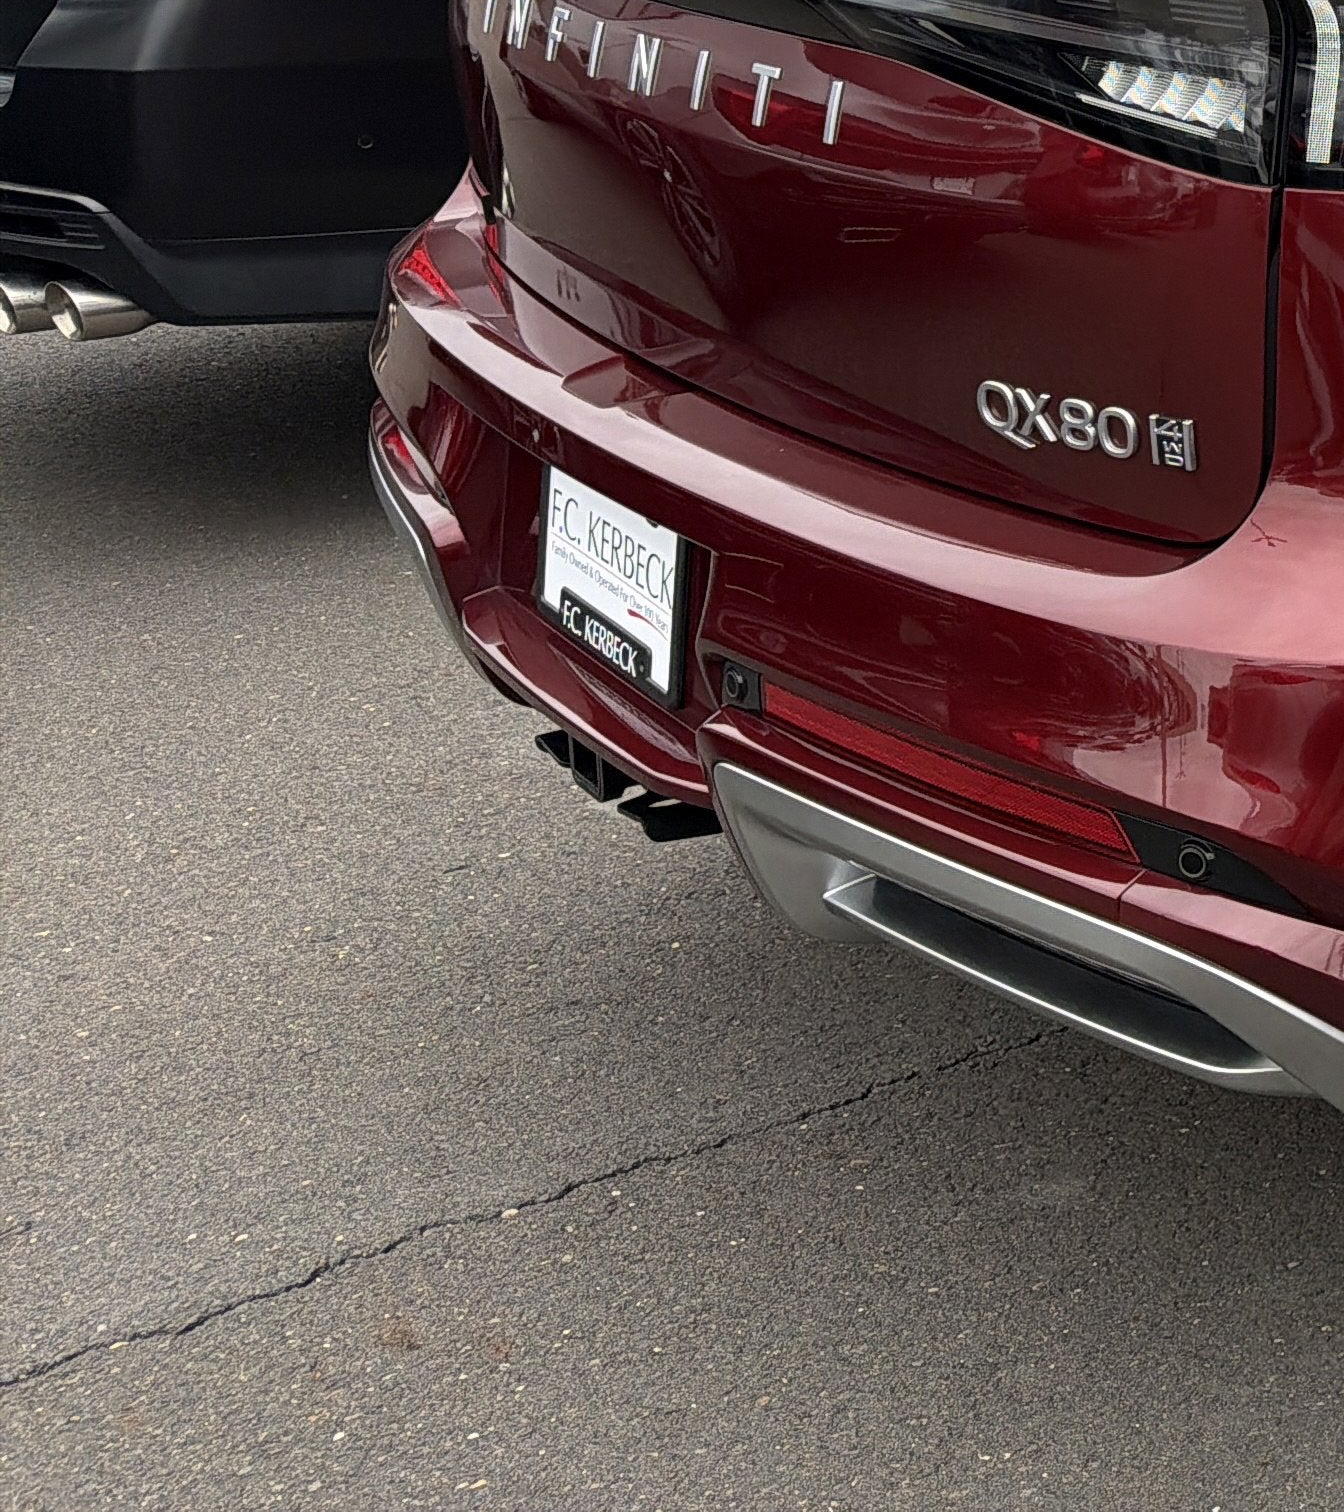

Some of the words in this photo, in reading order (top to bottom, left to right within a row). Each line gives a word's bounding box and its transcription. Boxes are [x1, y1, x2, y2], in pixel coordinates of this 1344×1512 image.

[976, 379, 1139, 460] QX80
[551, 487, 582, 546] F.C.
[587, 510, 675, 610] KERBECK
[562, 599, 583, 638] F.C.
[584, 616, 637, 678] KERBECK
